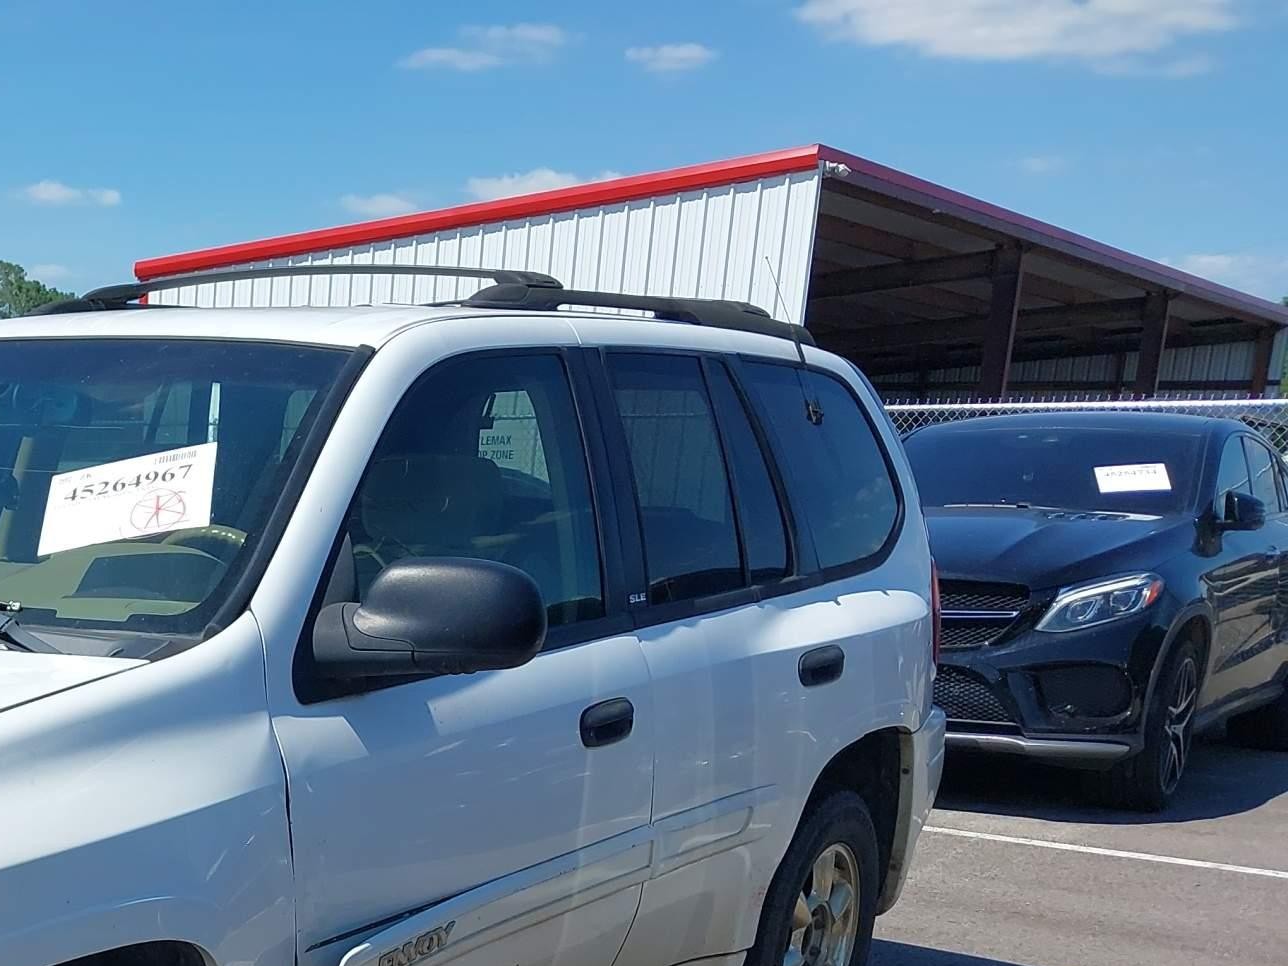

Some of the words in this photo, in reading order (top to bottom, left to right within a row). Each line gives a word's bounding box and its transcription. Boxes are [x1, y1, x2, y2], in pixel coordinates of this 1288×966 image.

[491, 449, 514, 460] ZONE
[64, 463, 193, 502] 45264967
[629, 592, 647, 604] SLE
